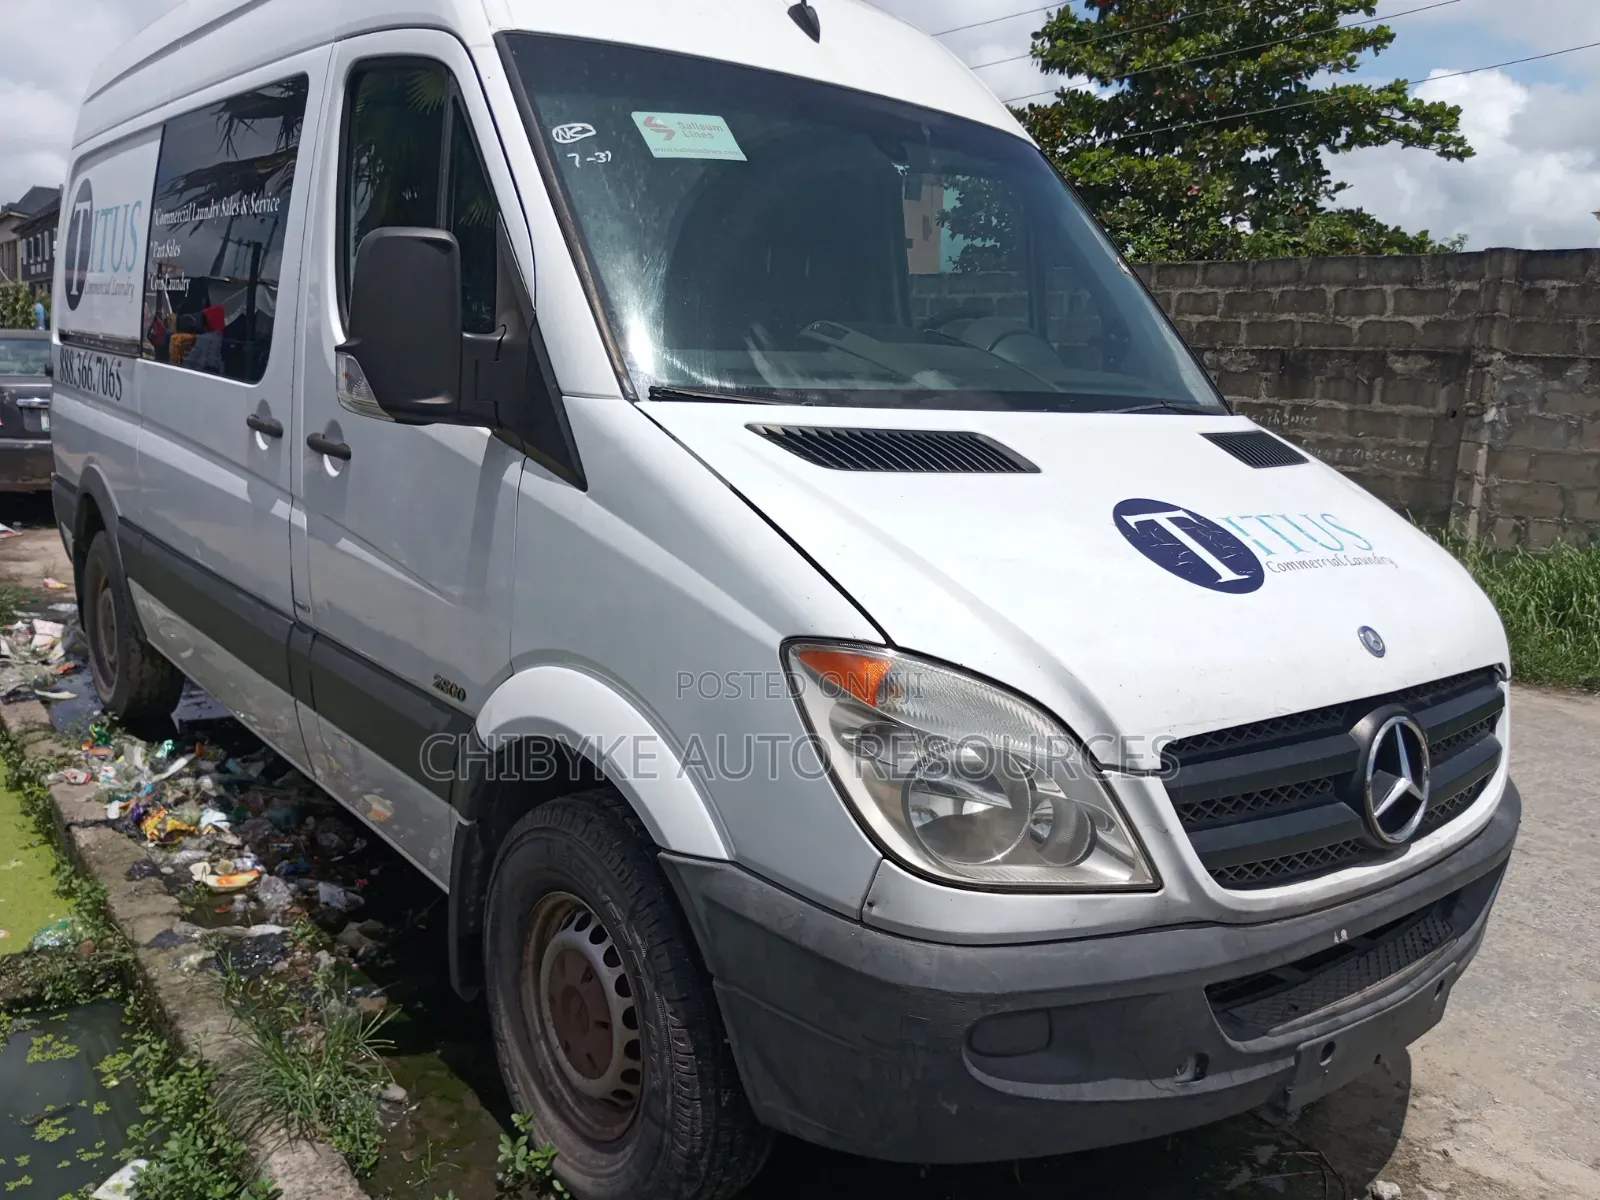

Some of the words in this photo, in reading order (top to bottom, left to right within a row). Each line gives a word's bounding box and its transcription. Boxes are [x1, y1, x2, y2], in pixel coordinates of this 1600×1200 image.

[677, 122, 724, 132] Sallaum
[682, 131, 714, 140] Lines
[192, 198, 222, 224] Laundry
[220, 196, 241, 217] Sales
[241, 194, 249, 214] &
[248, 191, 281, 214] Service
[166, 238, 181, 256] Sales
[165, 272, 191, 298] Laundry
[59, 347, 122, 402] 888.366.7065
[1266, 554, 1346, 574] Commercial
[1343, 552, 1399, 570] Laundry
